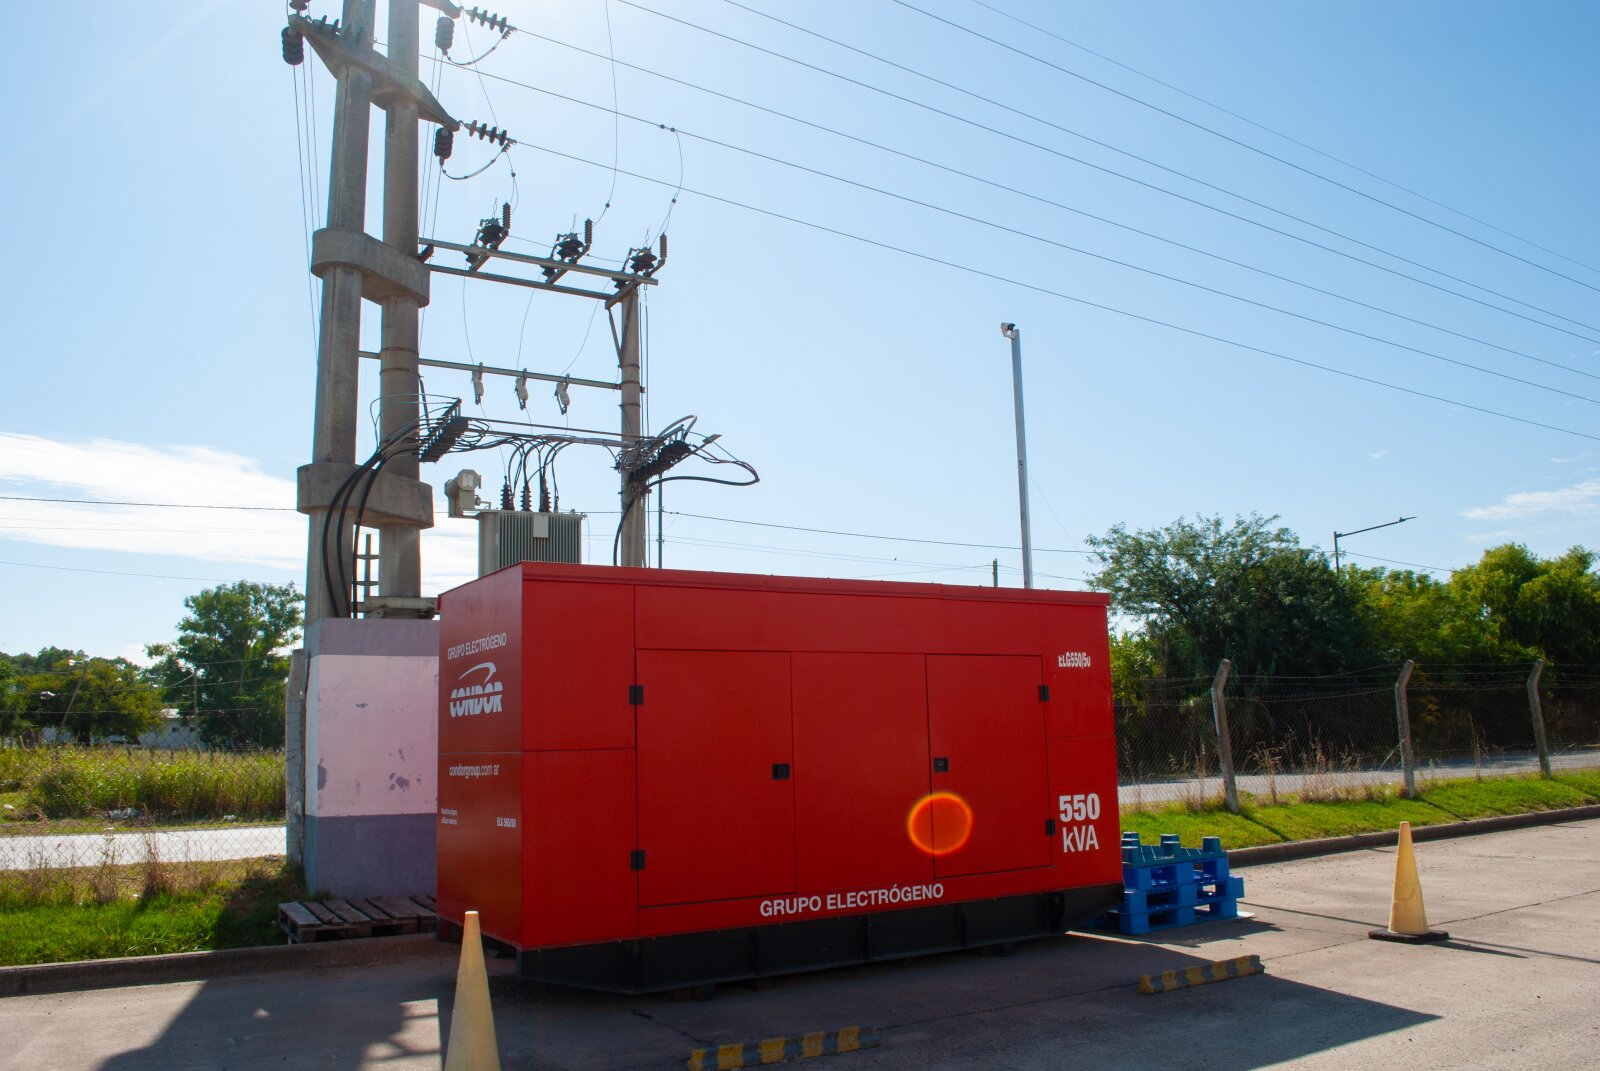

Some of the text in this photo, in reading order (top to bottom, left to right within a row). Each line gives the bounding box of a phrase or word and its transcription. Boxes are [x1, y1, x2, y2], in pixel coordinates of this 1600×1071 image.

[447, 632, 507, 660] GRUPO ELECTRÓGENO
[450, 681, 503, 718] CONDOR
[1059, 793, 1100, 822] 550
[1062, 824, 1099, 853] kVA
[760, 883, 944, 917] GRUPO ELECTRÓGENO
